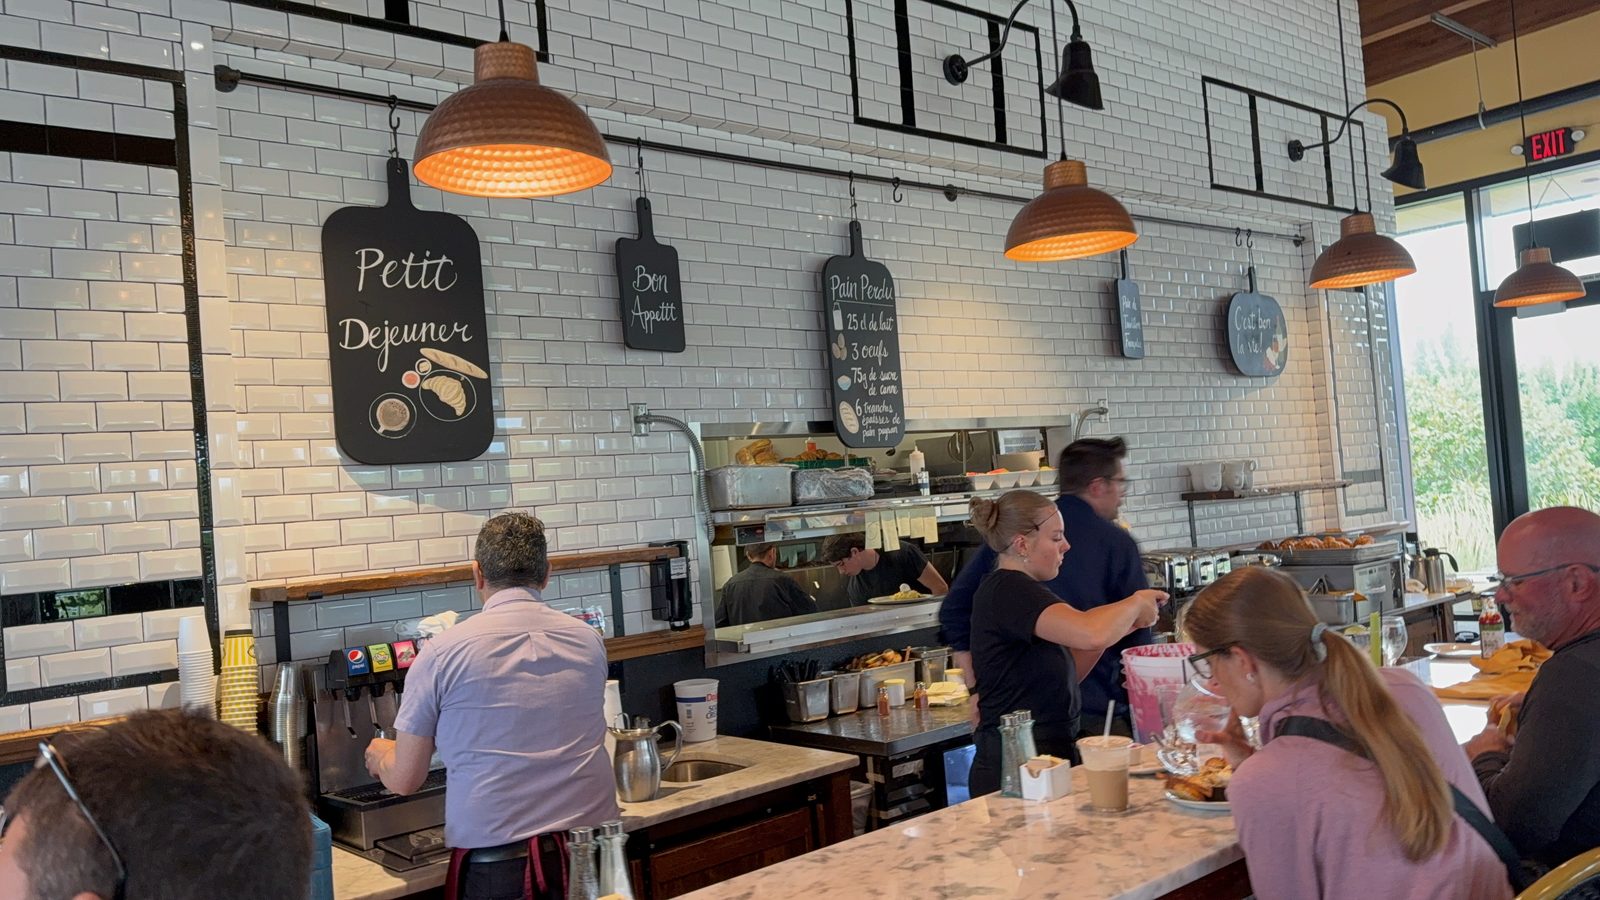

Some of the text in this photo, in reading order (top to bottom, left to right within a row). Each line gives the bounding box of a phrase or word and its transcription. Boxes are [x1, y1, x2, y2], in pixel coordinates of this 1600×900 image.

[1531, 128, 1566, 160] EXIT
[354, 248, 458, 292] Petit
[632, 265, 669, 293] Bon
[830, 273, 894, 301] Pain Perdu
[630, 294, 678, 334] Appetit
[846, 313, 859, 331] 25
[869, 312, 878, 332] de
[878, 310, 894, 332] lait
[1258, 307, 1271, 329] bon
[339, 318, 473, 373] Dejeuner
[851, 339, 889, 366] 3 oeufs
[851, 366, 898, 390] 75g de sucre
[868, 382, 878, 396] de
[855, 398, 863, 417] 6
[892, 413, 901, 425] de
